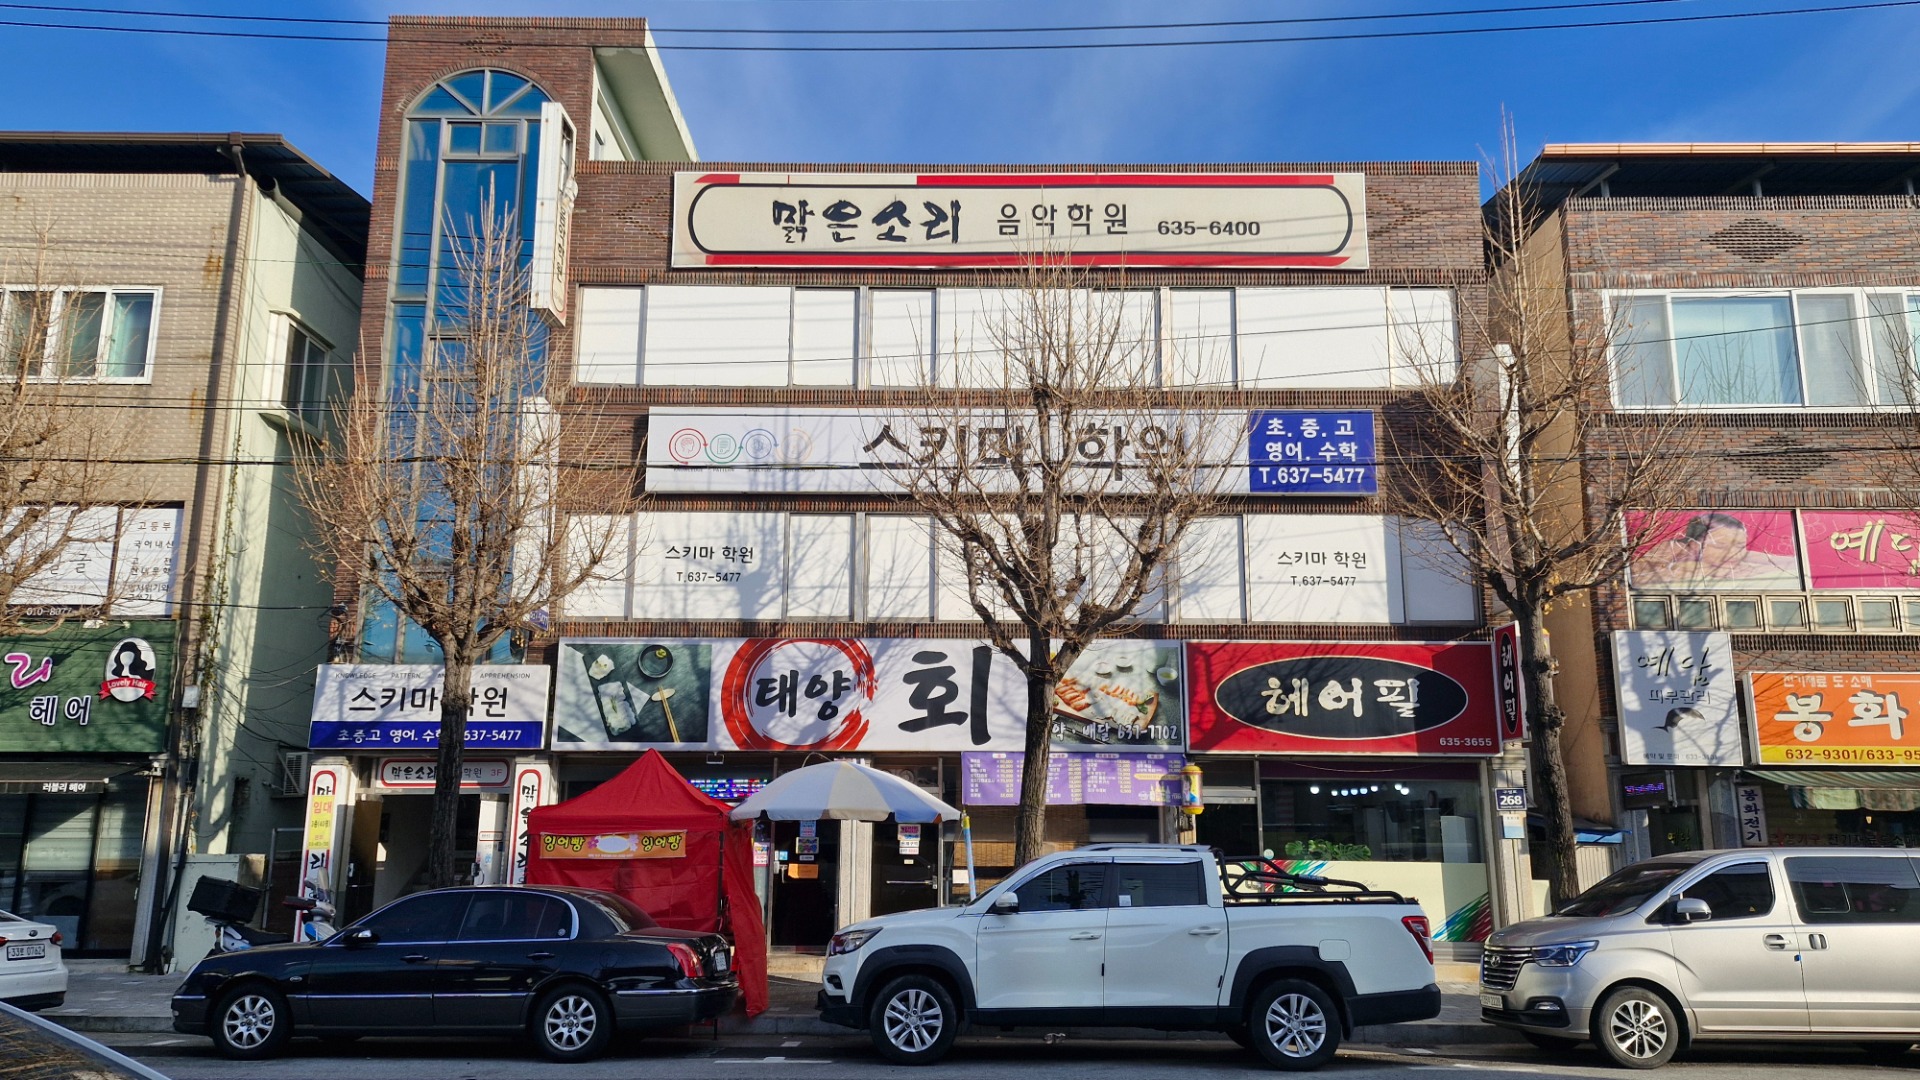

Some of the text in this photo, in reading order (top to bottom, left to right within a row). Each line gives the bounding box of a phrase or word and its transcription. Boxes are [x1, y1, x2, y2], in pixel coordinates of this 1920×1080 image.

[772, 200, 1261, 243] 맑은소리 음악학원 635-6400
[1265, 441, 1359, 462] 영어. 수학
[1258, 466, 1365, 485] T.637-5477
[665, 546, 753, 563] 스키마 학원
[1277, 551, 1366, 569] 스키마 학원
[677, 572, 741, 584] T.637-5477
[1290, 576, 1356, 587] T.637-5477
[107, 680, 149, 689] Lovely Hair
[1501, 643, 1516, 721] 헤어필
[1783, 675, 1827, 688] 전기재료
[349, 687, 437, 712] 스키마
[755, 669, 851, 720] 태양
[898, 645, 992, 746] 회
[1261, 677, 1421, 718] 헤어필
[30, 695, 91, 725] 헤어
[1774, 689, 1909, 743] 봉화
[1118, 722, 1178, 739] 637-7702
[1440, 737, 1493, 747] 635-3655
[42, 782, 86, 792] 러블리 헤어
[313, 801, 333, 814] 임대
[1500, 795, 1523, 805] 268
[1741, 790, 1763, 842] 봉화전기
[544, 834, 682, 852] 잉어빵 잉어빵
